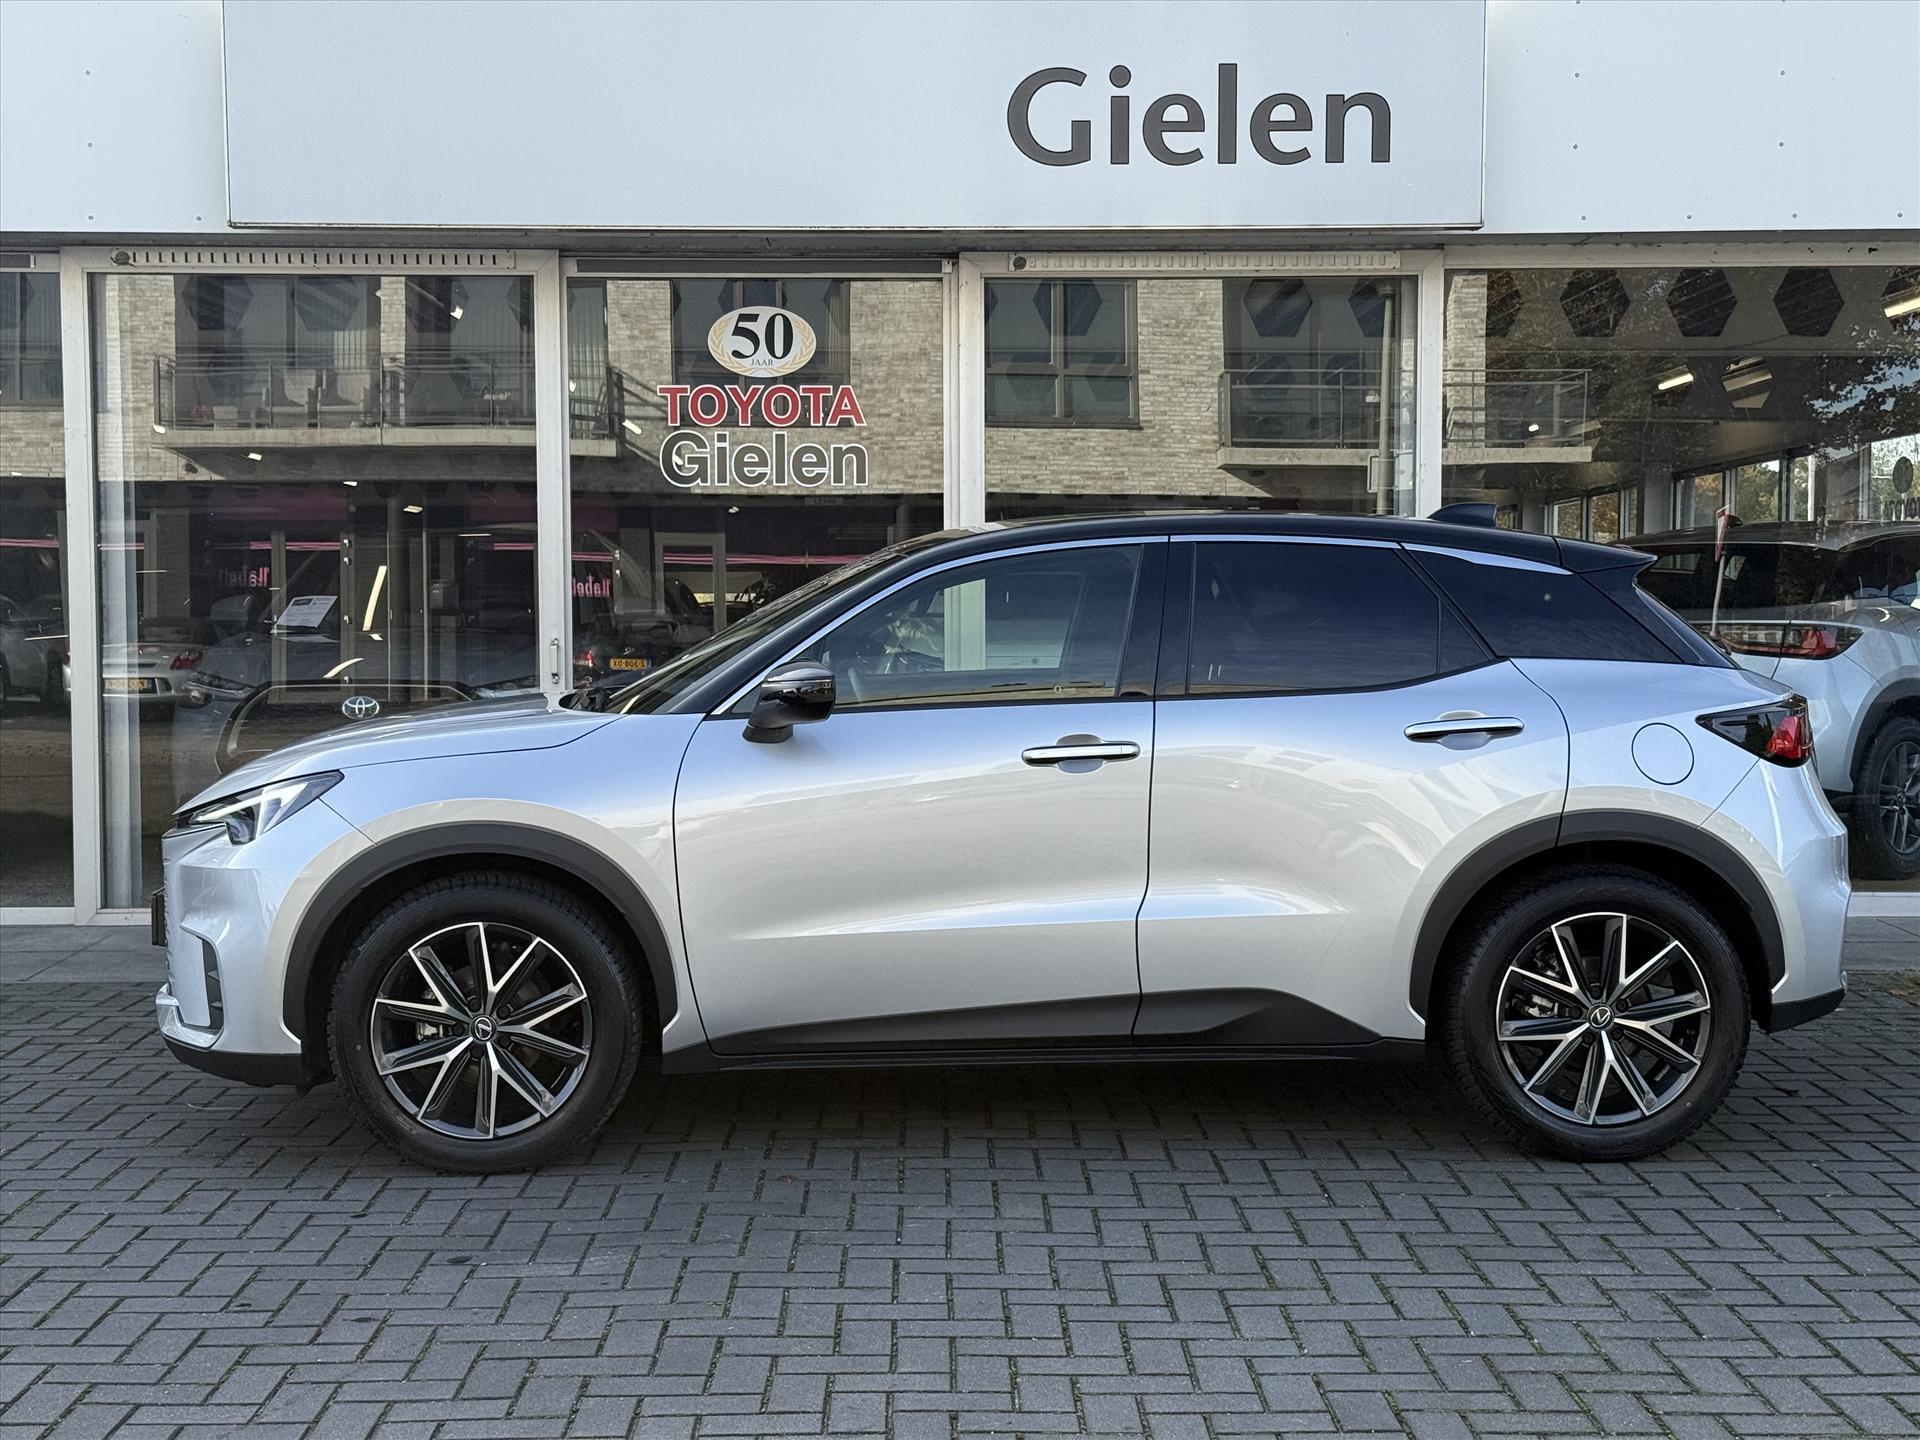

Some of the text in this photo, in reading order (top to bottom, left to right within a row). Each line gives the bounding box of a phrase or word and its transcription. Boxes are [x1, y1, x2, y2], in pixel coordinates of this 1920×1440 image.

[1007, 63, 1391, 167] Gielen
[731, 313, 794, 360] 50
[750, 358, 774, 367] JAAR
[657, 384, 868, 427] TOYOTA
[660, 430, 869, 488] Gielen
